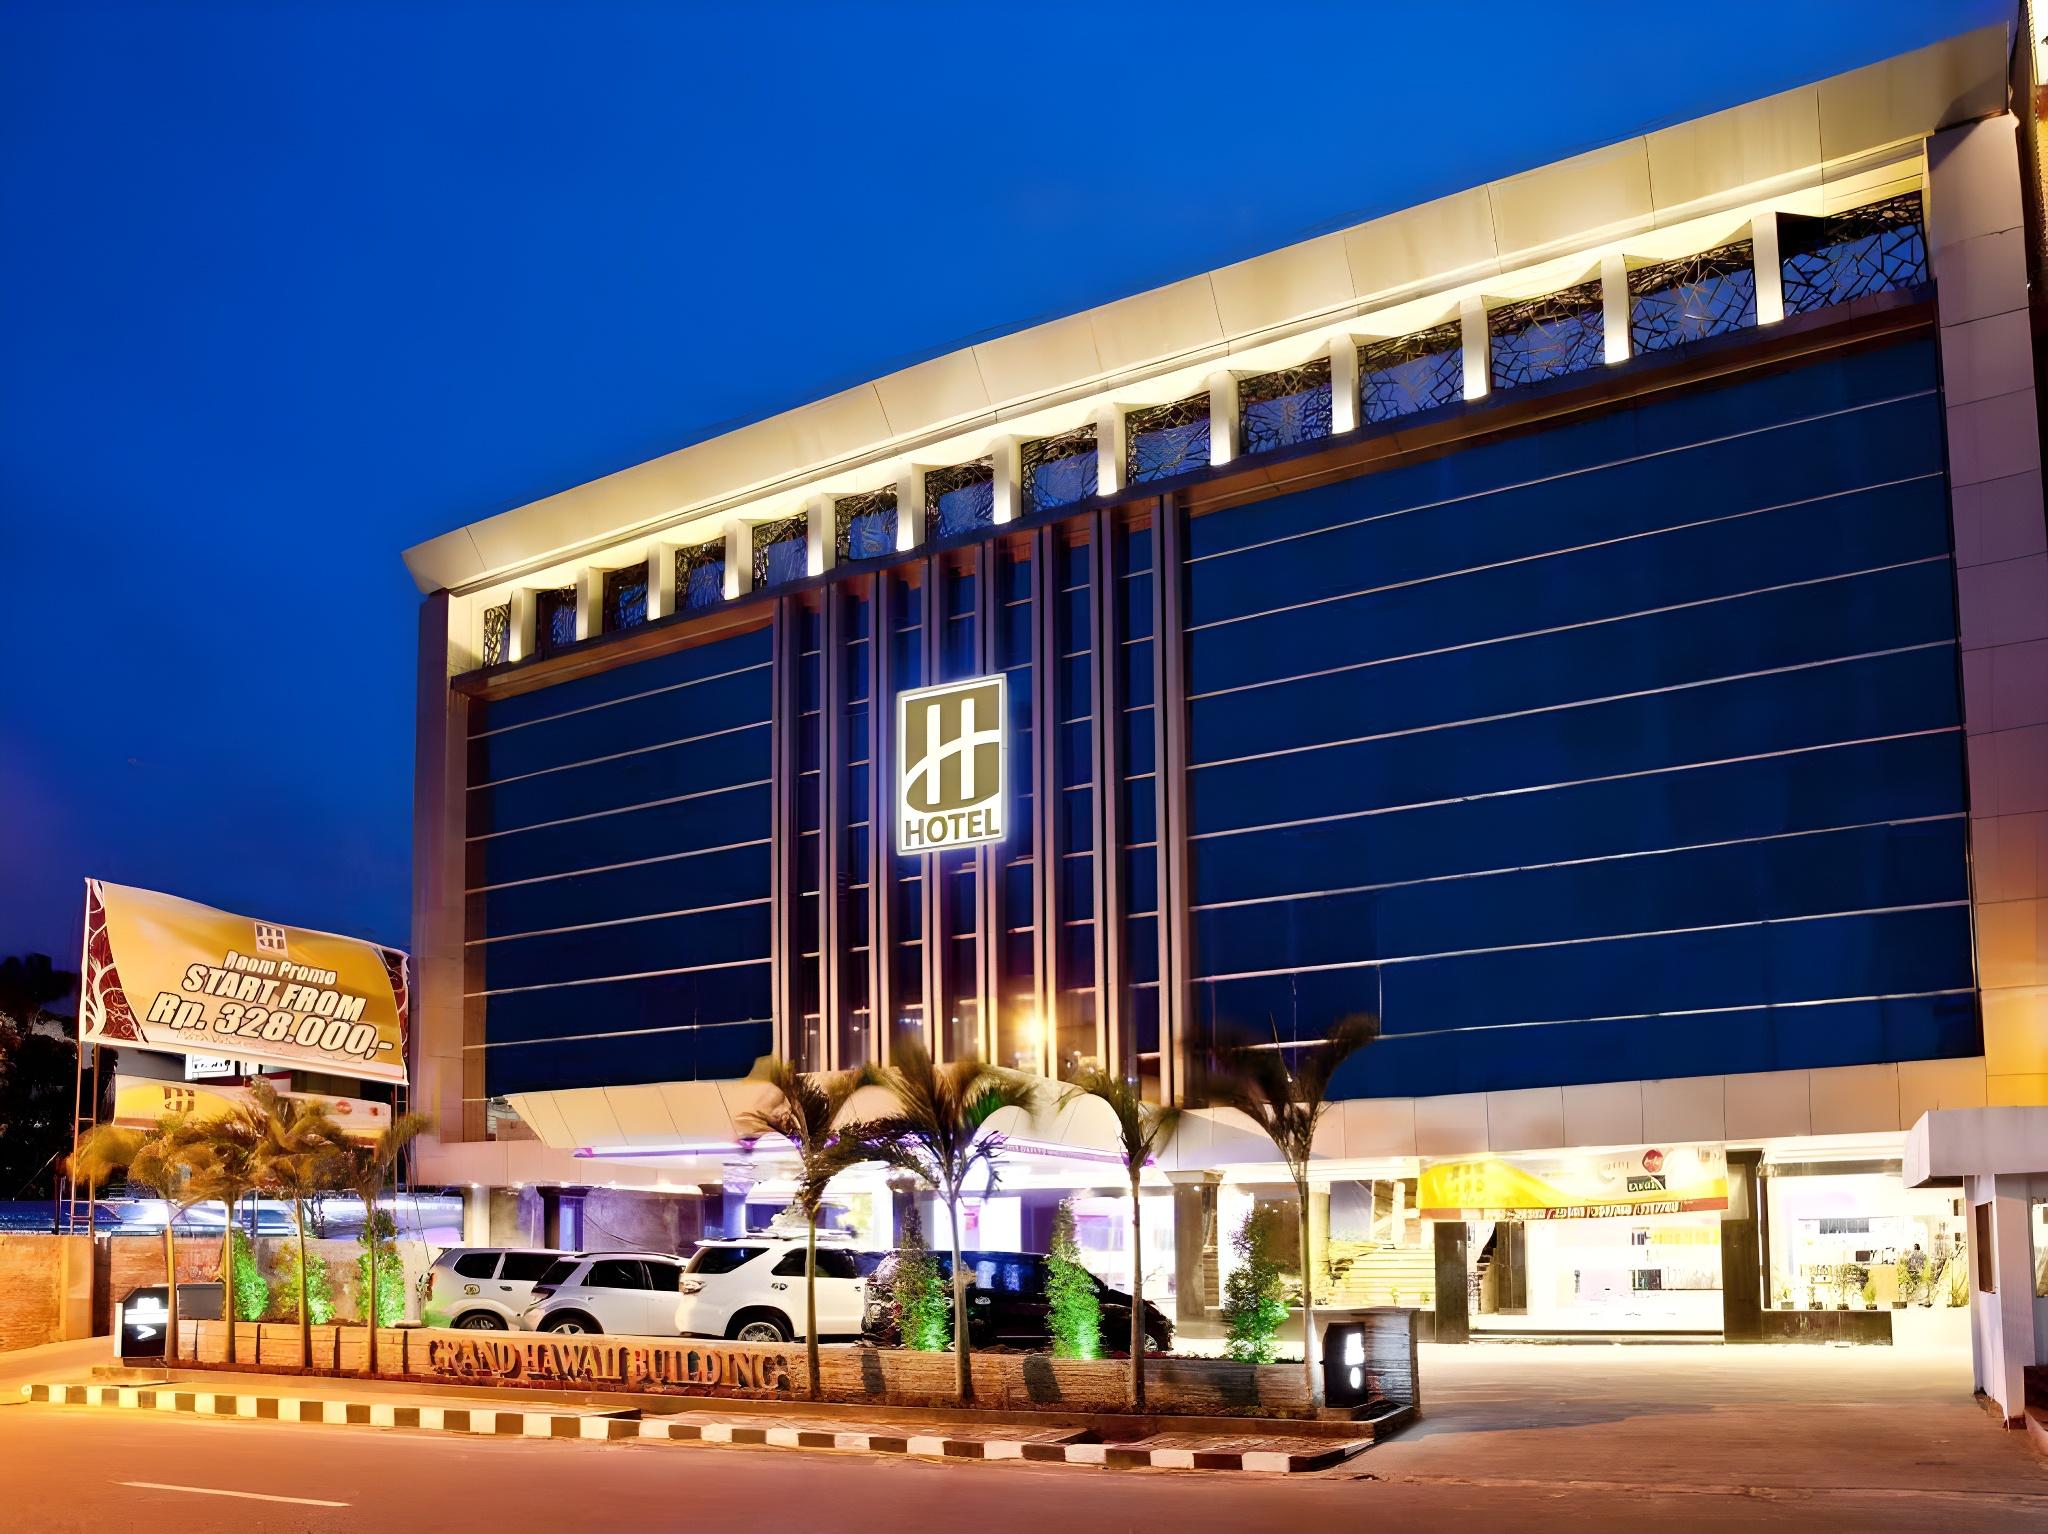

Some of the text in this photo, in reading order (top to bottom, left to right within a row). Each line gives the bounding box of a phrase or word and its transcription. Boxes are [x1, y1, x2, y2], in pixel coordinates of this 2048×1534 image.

[906, 808, 999, 846] HOTEL
[182, 963, 366, 1021] START FROM
[279, 961, 337, 985] Promo
[147, 992, 206, 1029] Rp.
[213, 1002, 394, 1060] 328.000,-
[429, 1340, 517, 1377] GRAND
[627, 1349, 788, 1390] BUILDING
